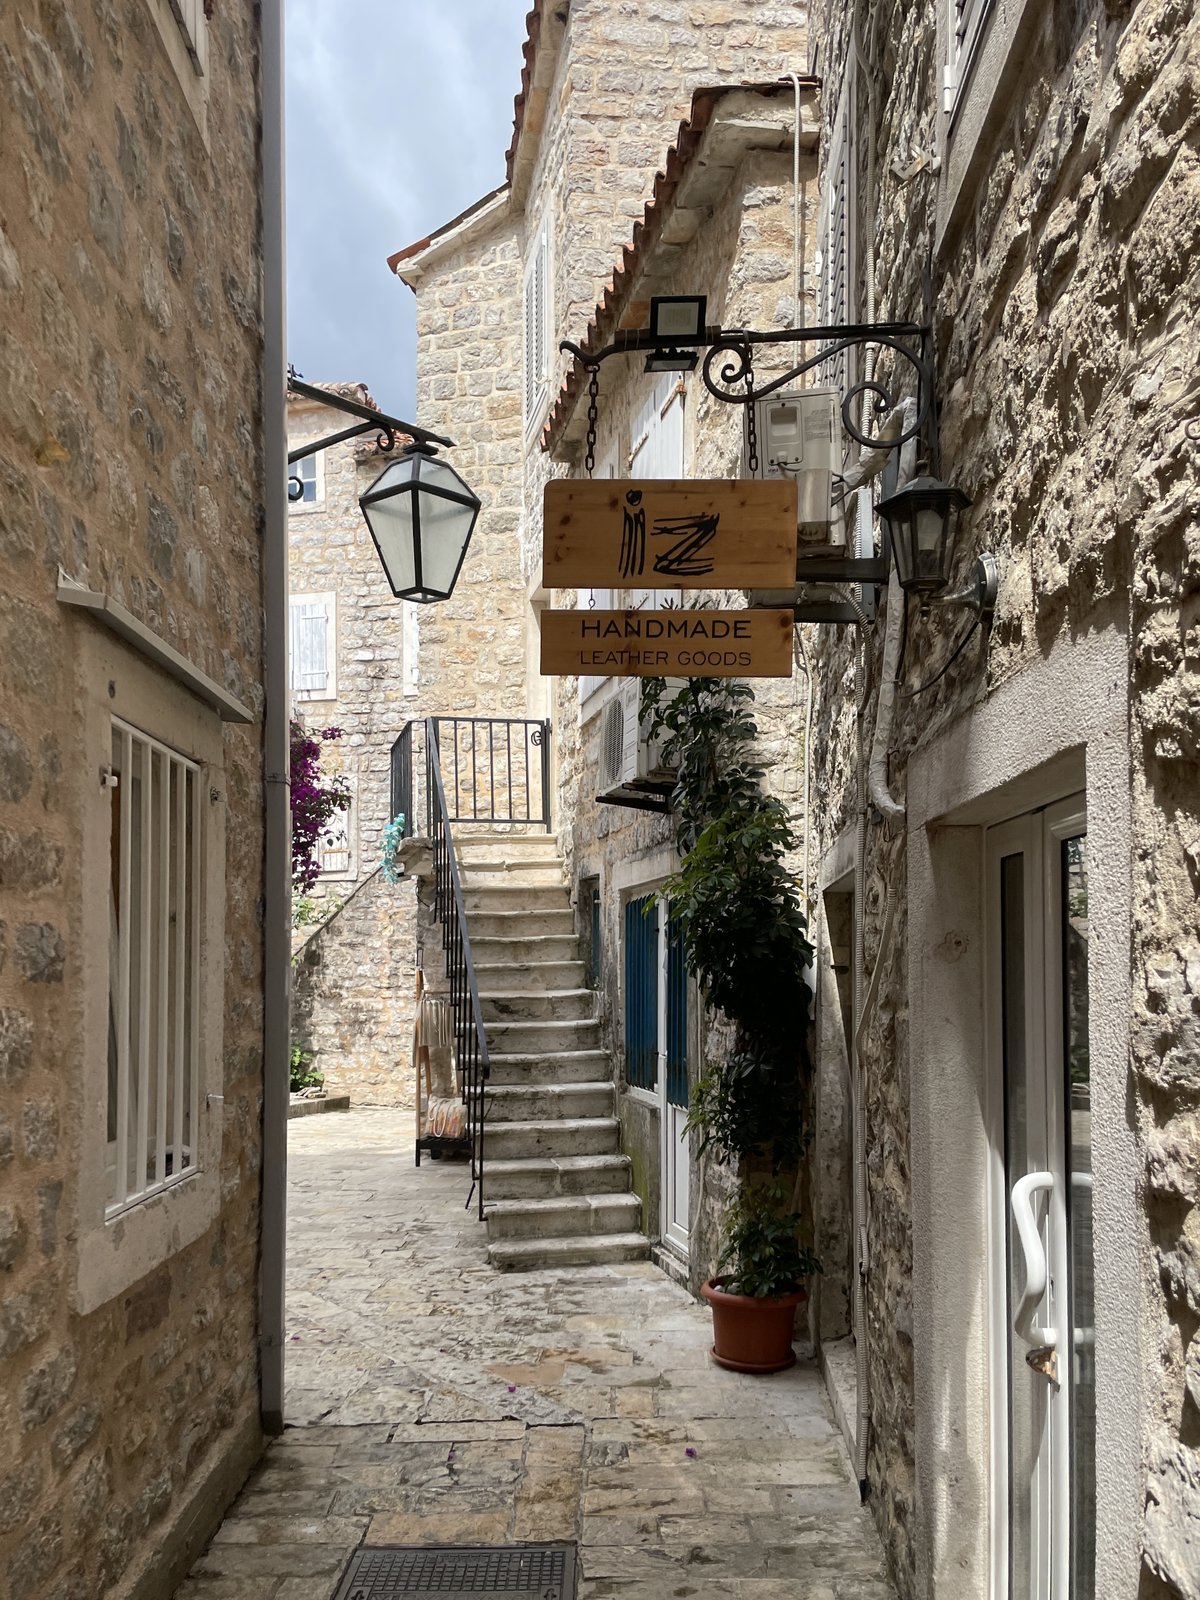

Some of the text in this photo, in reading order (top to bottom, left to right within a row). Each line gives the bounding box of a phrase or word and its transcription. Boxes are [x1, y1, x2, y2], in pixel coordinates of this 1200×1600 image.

[581, 619, 752, 639] HANDMADE
[580, 650, 752, 666] LEATHER GOODS
